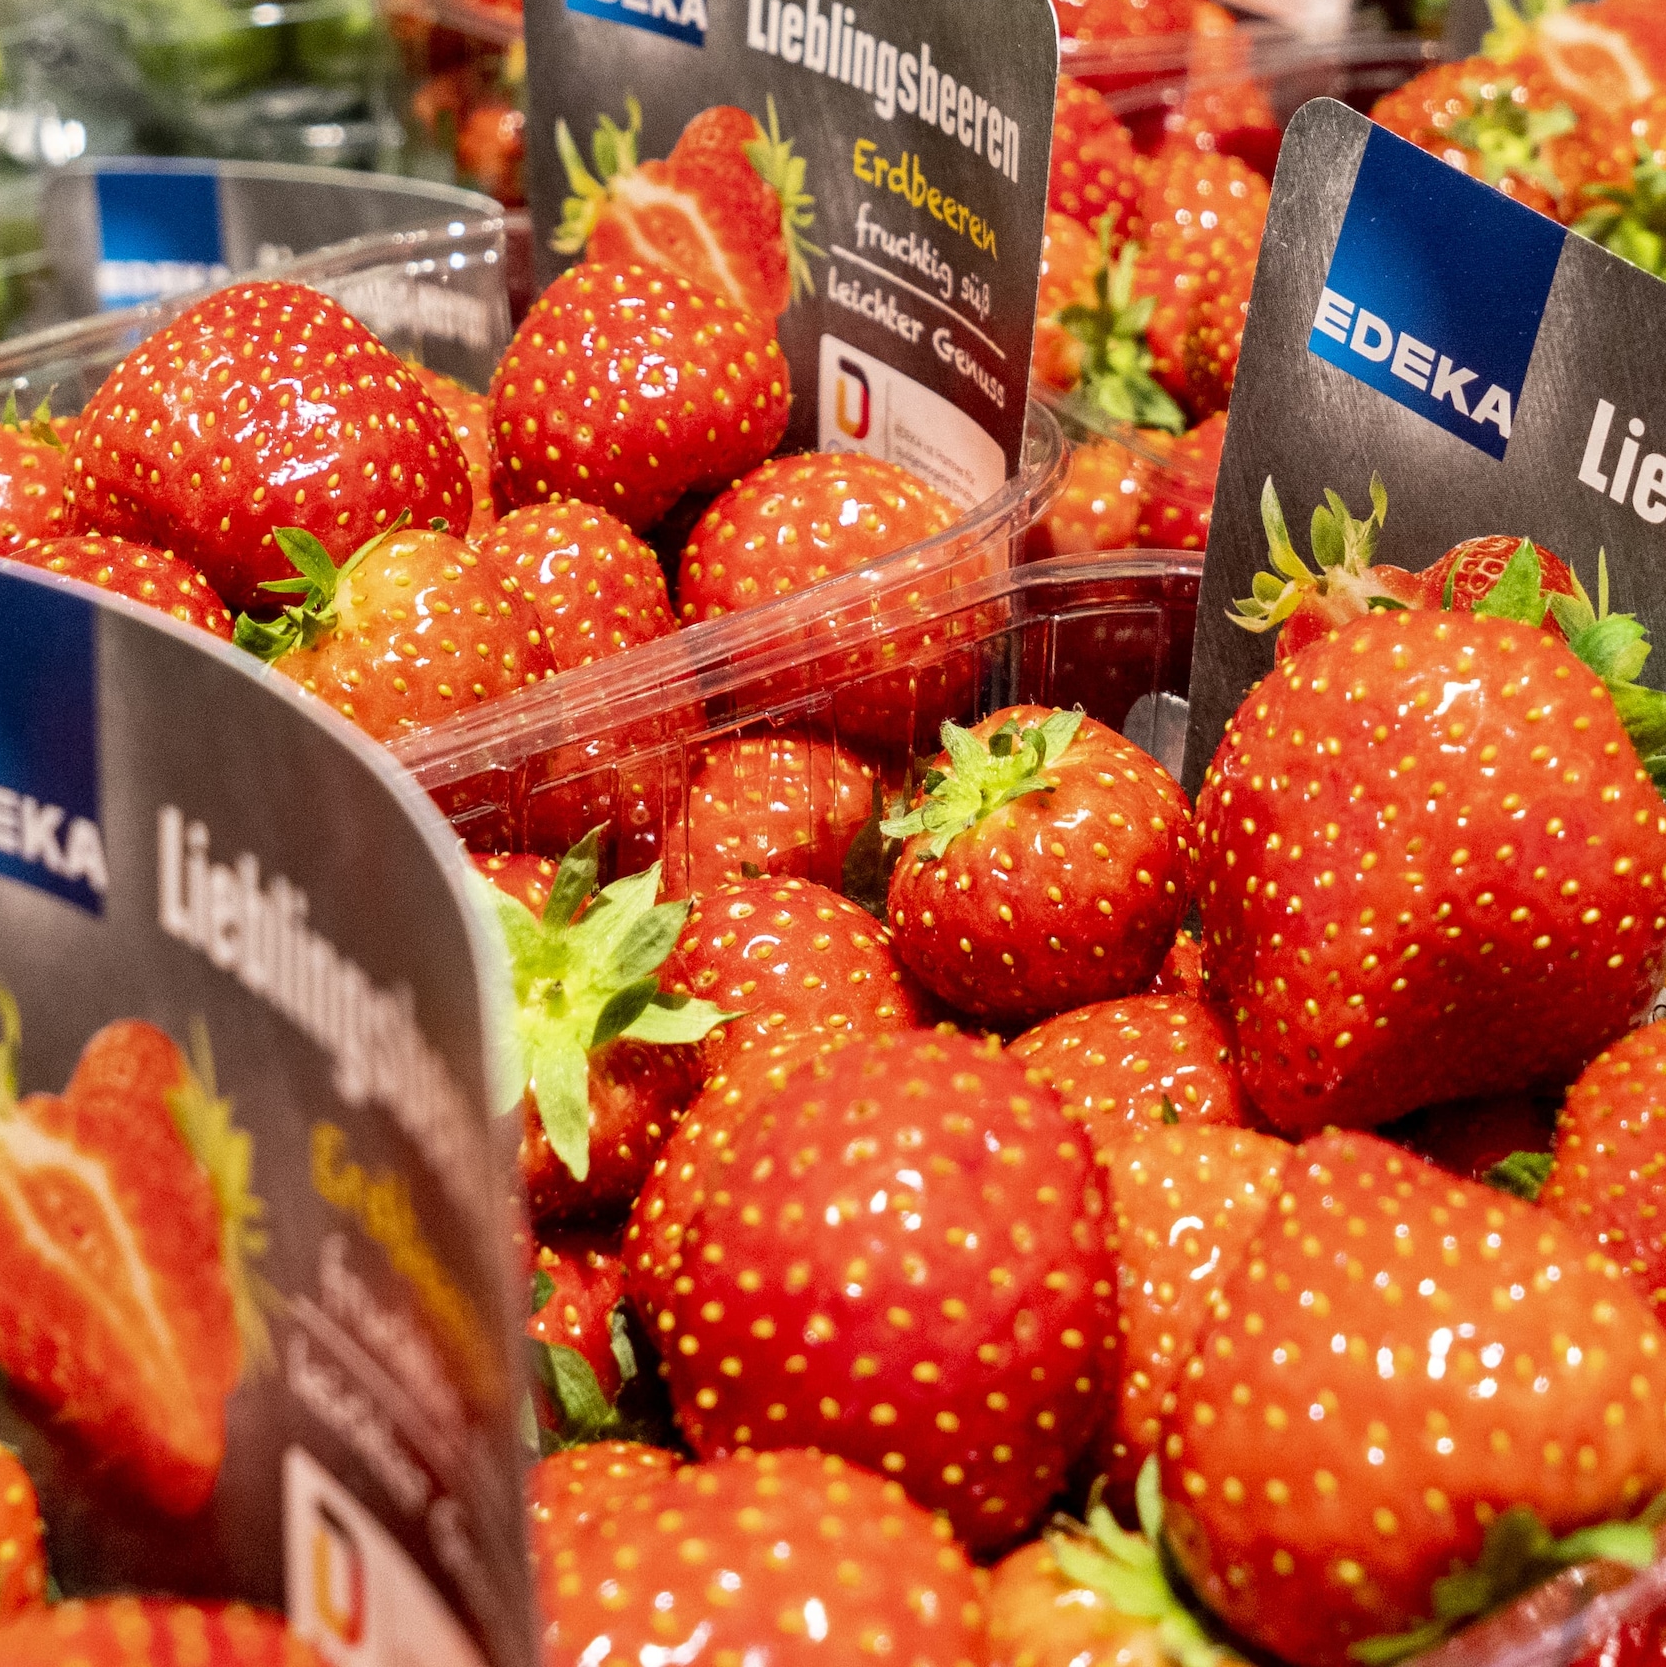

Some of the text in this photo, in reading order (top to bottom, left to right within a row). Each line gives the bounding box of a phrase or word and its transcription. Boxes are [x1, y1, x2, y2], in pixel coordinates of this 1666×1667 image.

[852, 138, 998, 260] Erdbeeren
[855, 202, 991, 320] fruchtig süß
[932, 327, 1006, 409] Genuss
[1312, 286, 1512, 440] EDEKA
